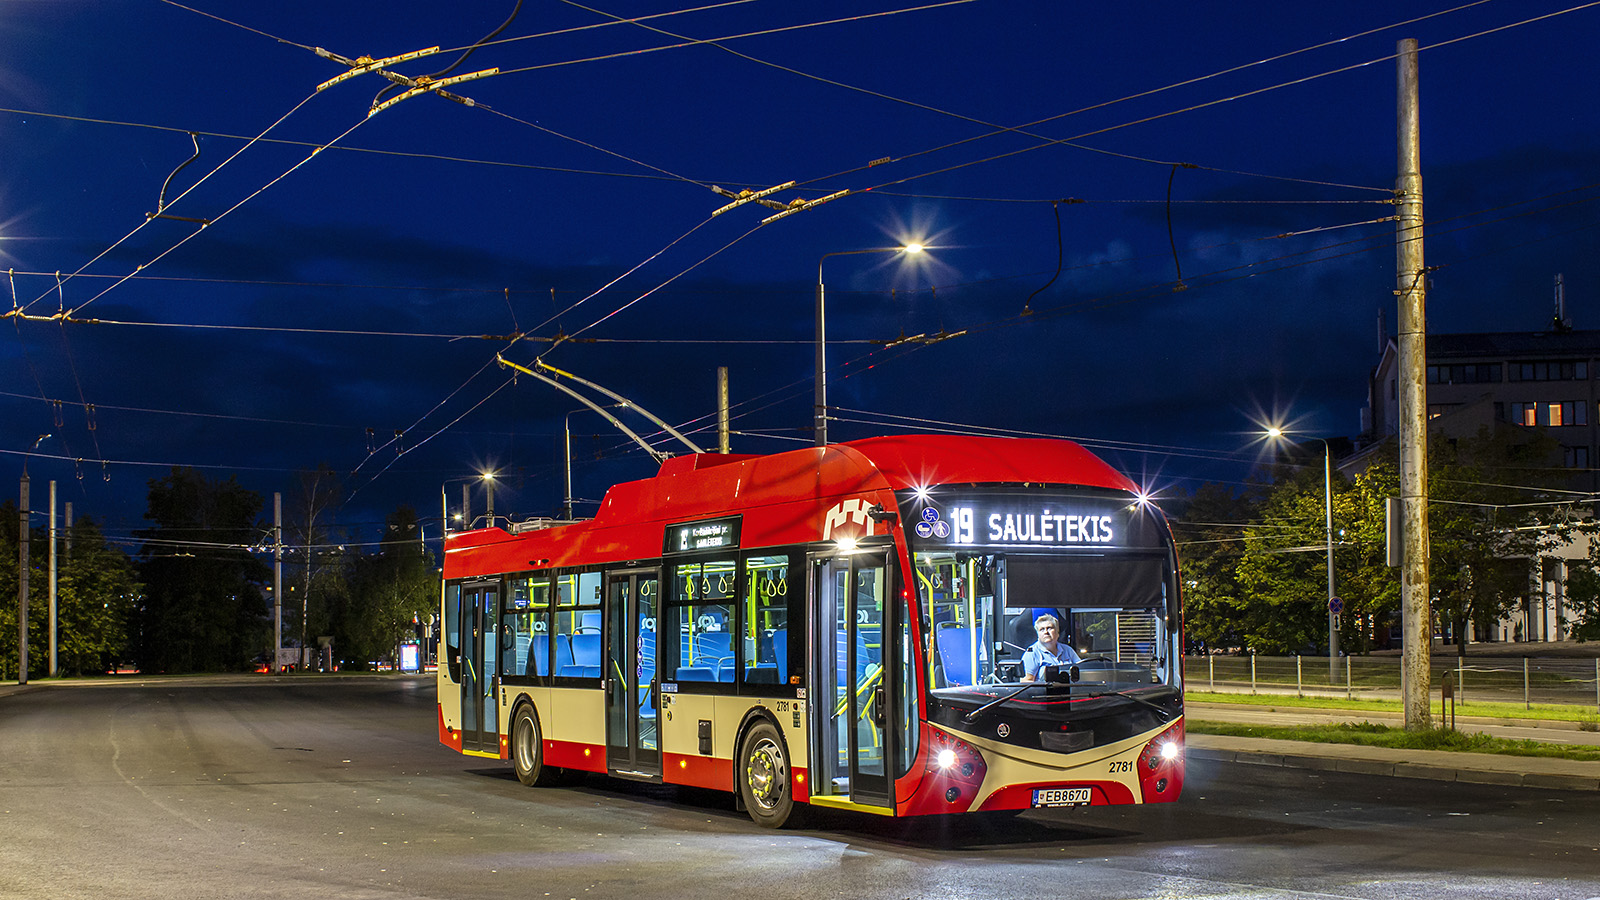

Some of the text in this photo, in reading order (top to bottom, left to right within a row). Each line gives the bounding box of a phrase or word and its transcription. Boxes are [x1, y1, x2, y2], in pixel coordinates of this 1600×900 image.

[950, 507, 1113, 543] 19 SAULĖTEKIS
[776, 701, 790, 712] 2781
[1108, 760, 1134, 773] 2781
[1046, 790, 1088, 802] EB8670
